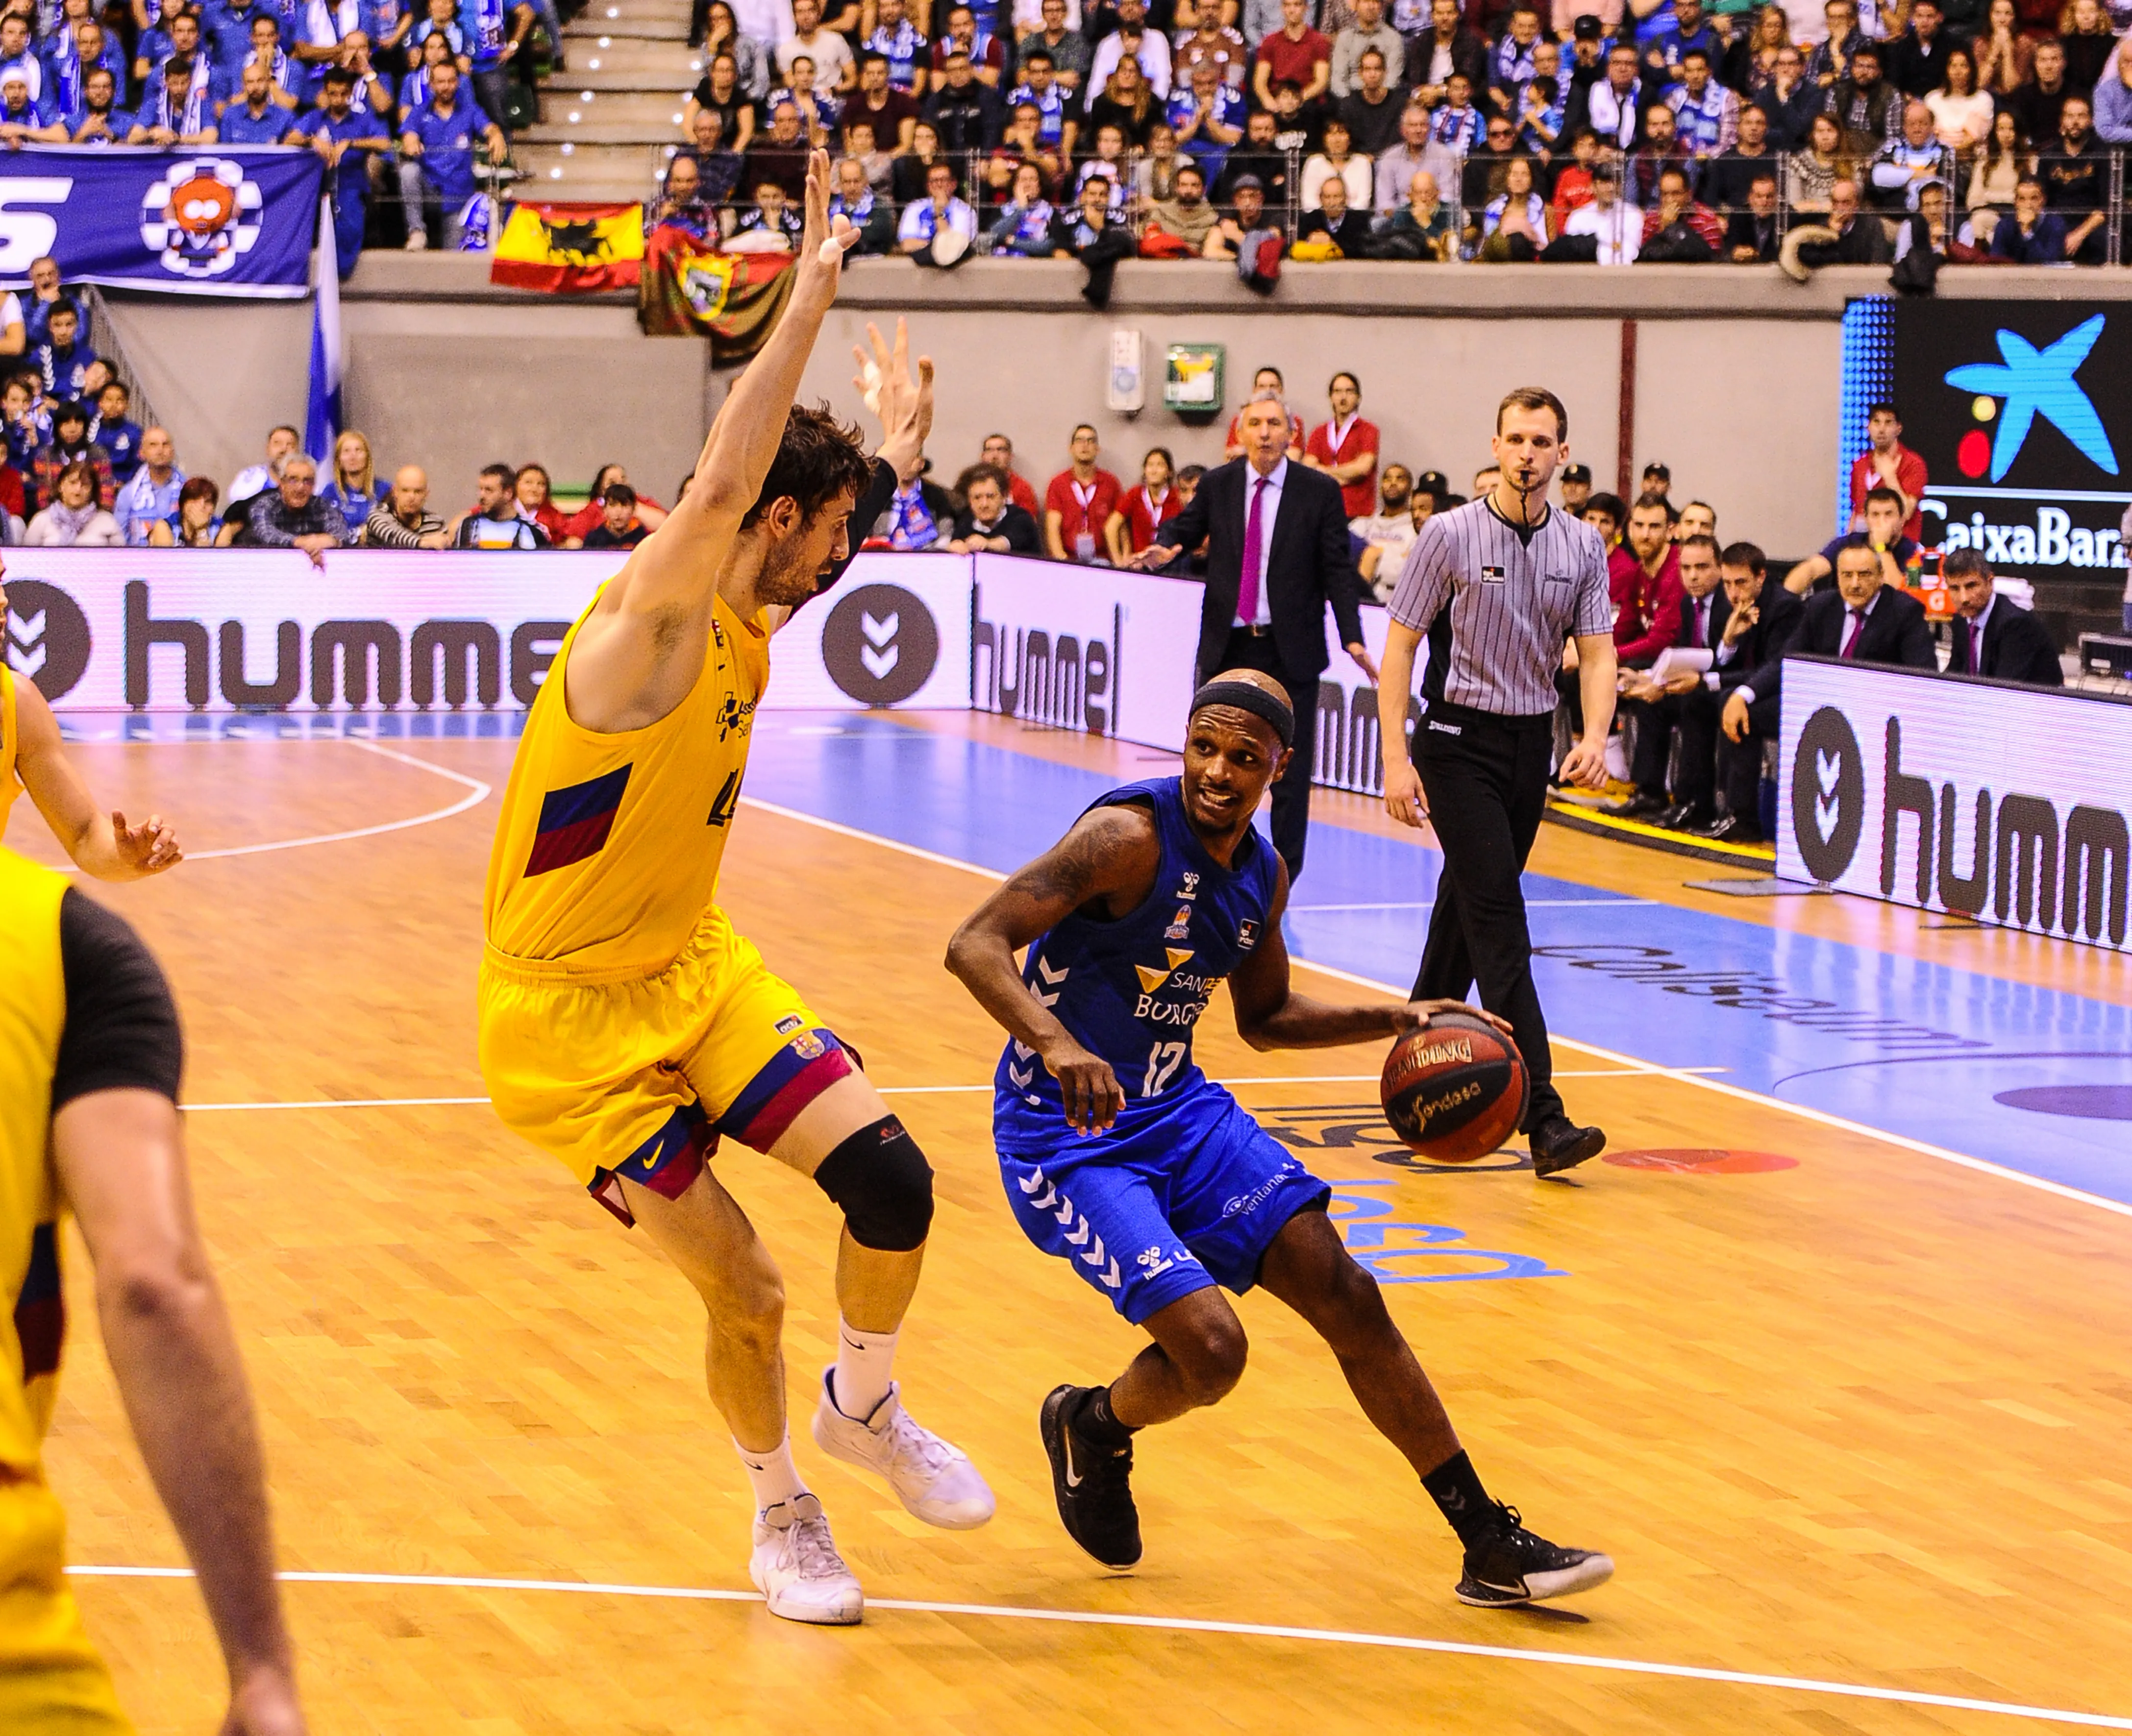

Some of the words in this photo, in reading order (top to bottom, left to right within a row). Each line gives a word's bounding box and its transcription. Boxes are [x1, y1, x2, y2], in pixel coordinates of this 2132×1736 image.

[125, 580, 573, 705] humme
[974, 582, 1121, 737] hummel
[1532, 944, 1991, 1050] Coliseum
